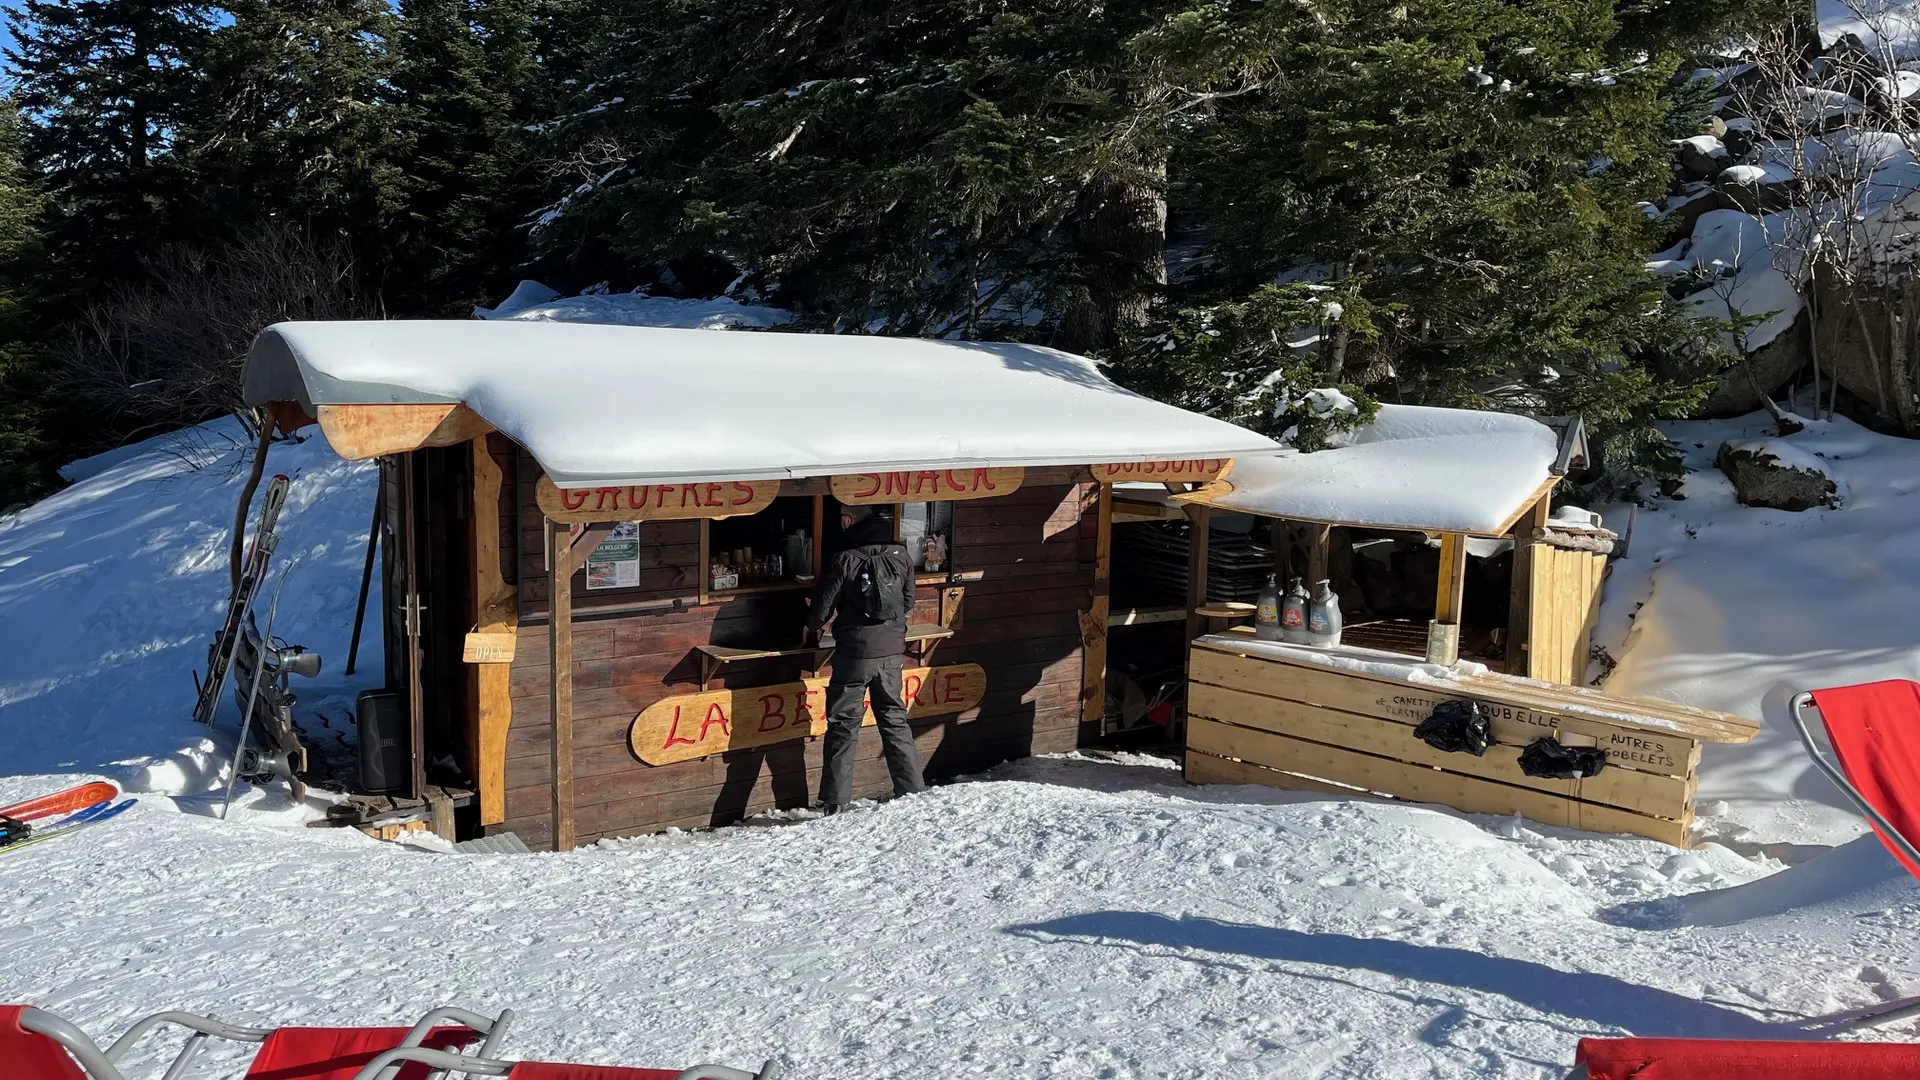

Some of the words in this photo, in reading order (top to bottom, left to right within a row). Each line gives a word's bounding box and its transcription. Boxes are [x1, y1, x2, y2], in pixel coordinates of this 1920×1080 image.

[854, 467, 996, 498] SNACK
[560, 481, 754, 511] GAUFRES
[475, 646, 503, 661] OPEN
[662, 702, 730, 750] LA
[758, 669, 967, 733] BERIE
[1393, 696, 1437, 708] CANETTE
[1385, 705, 1428, 721] PLASTIQ
[1481, 704, 1561, 729] OUBELLE
[1610, 733, 1664, 753] AUTRES
[1603, 747, 1675, 767] GOBELETS
